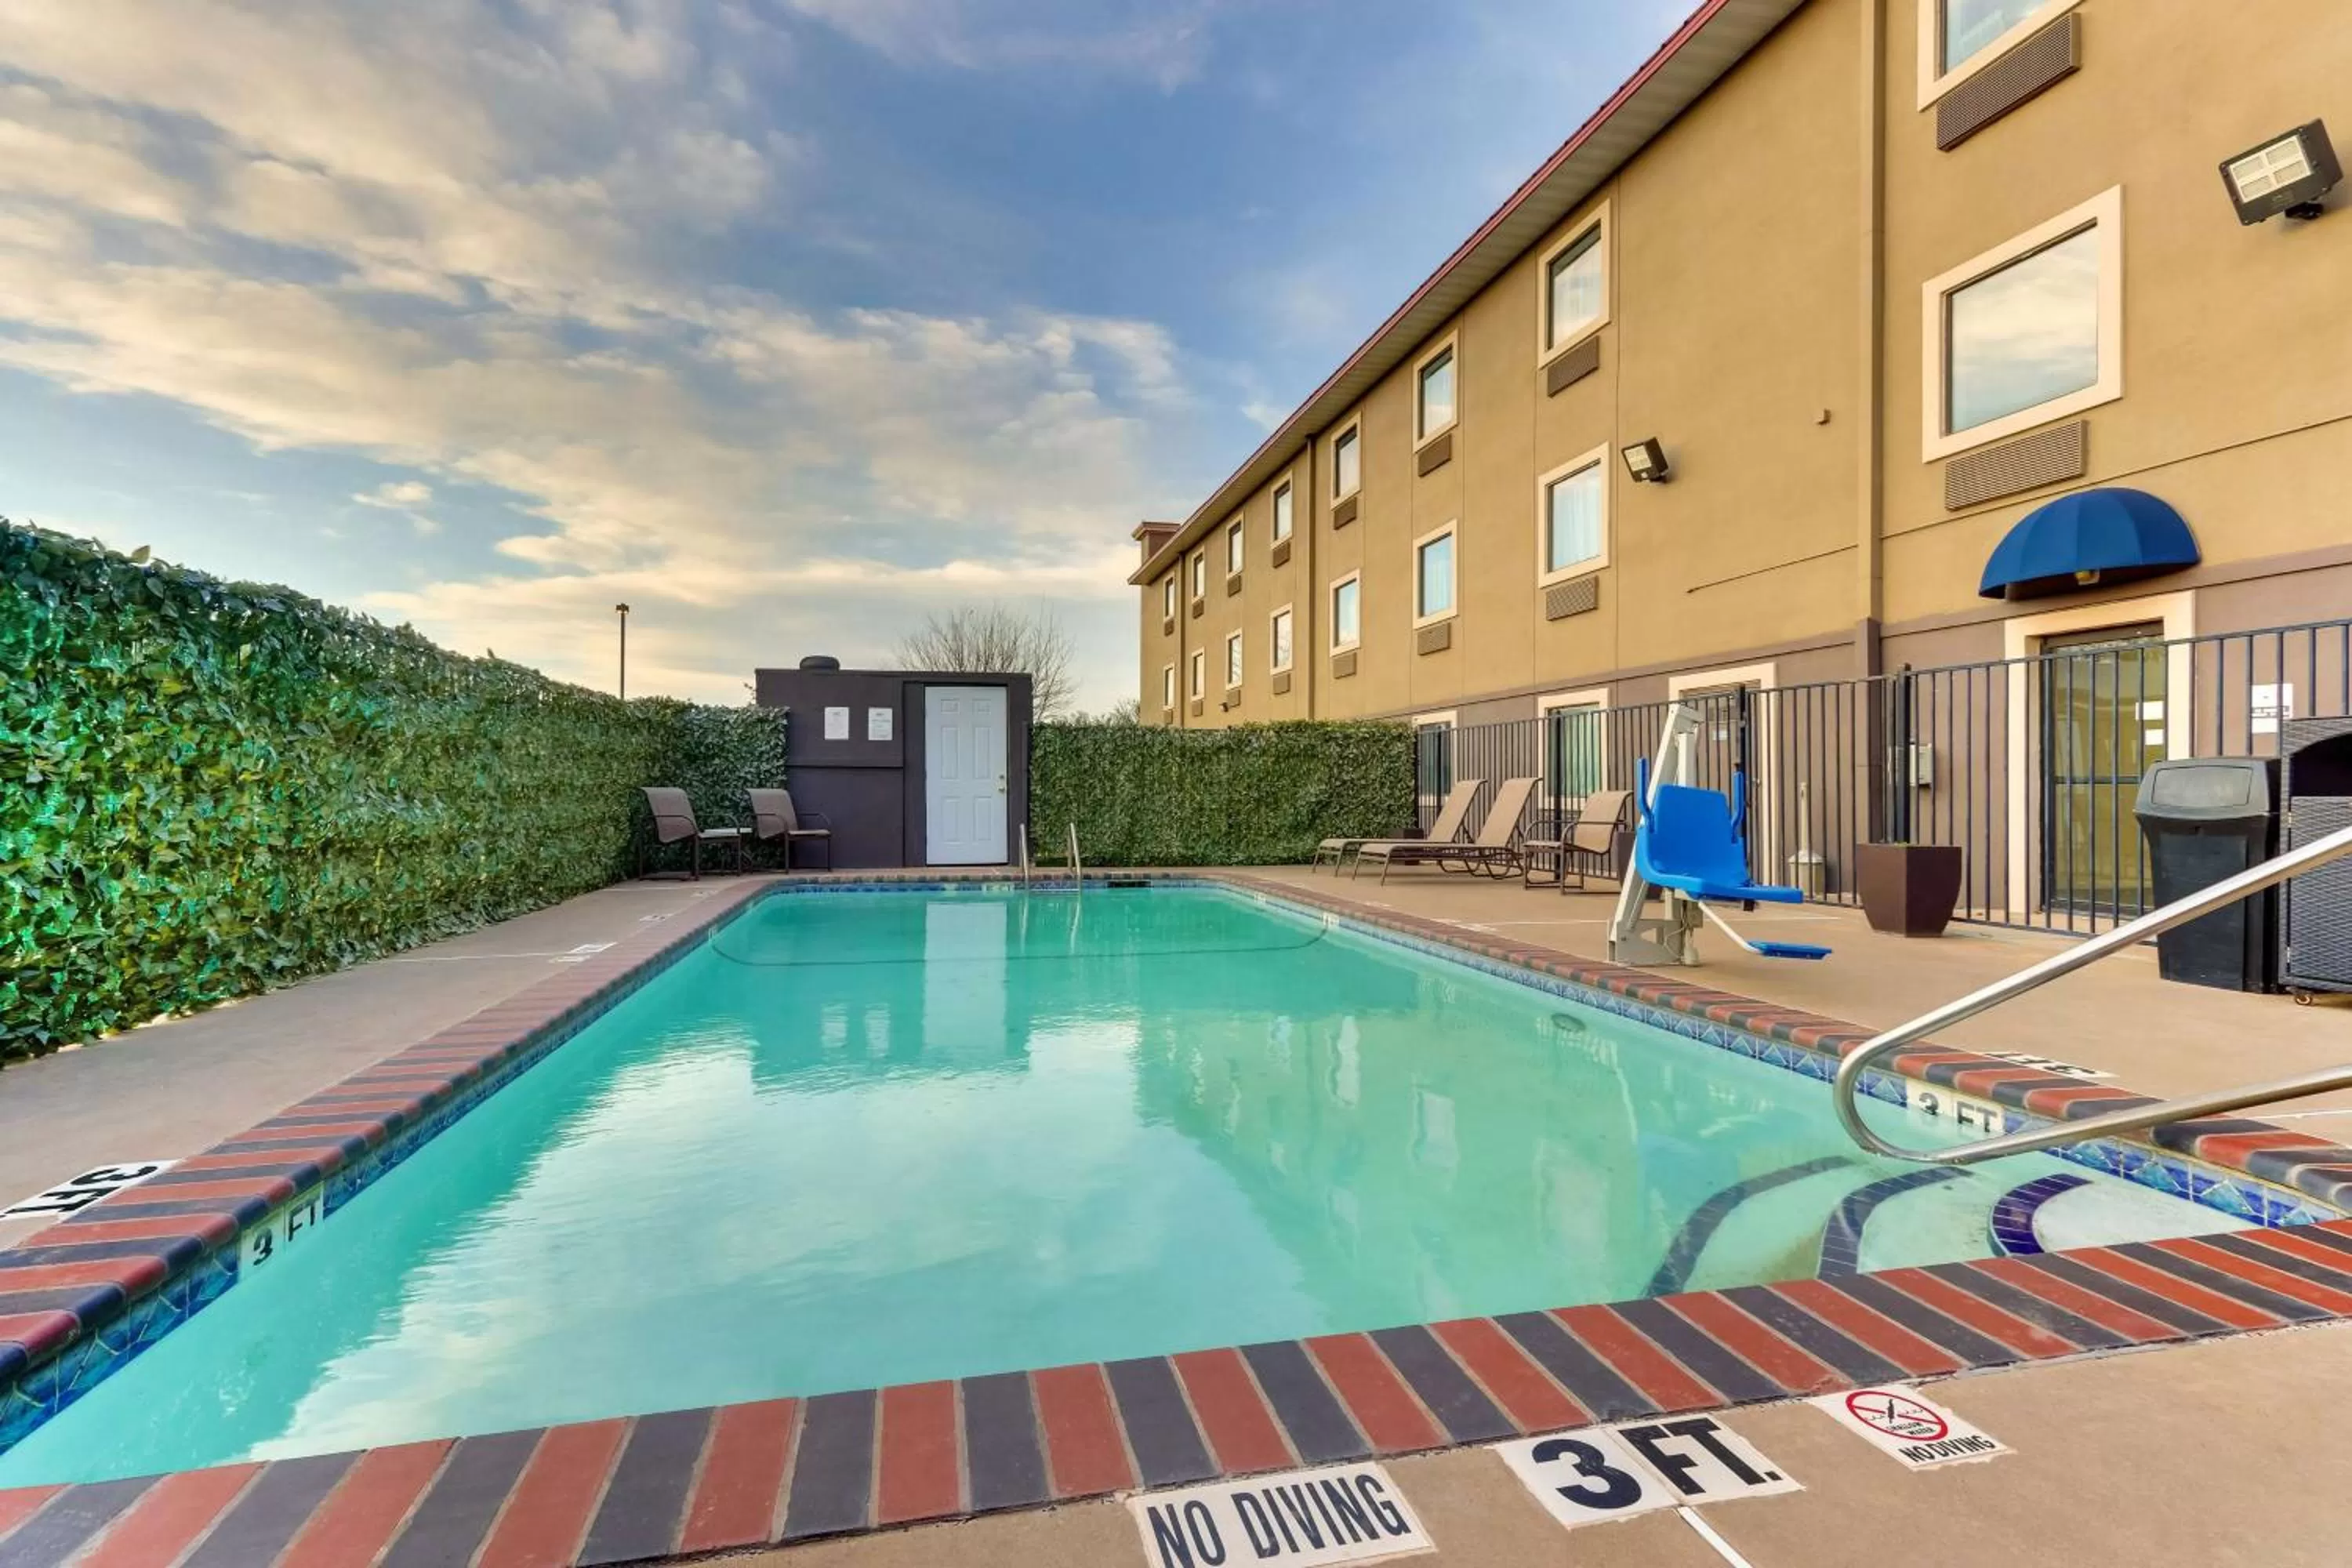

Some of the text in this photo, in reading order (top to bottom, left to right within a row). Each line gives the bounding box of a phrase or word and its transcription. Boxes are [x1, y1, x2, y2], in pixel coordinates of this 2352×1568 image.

[1956, 1101, 1998, 1133] FT
[253, 1228, 274, 1266] 3
[1531, 1417, 1784, 1509] 3 FT.
[1898, 1436, 1996, 1462] NO DIVING
[1147, 1474, 1413, 1568] NO DIVING
